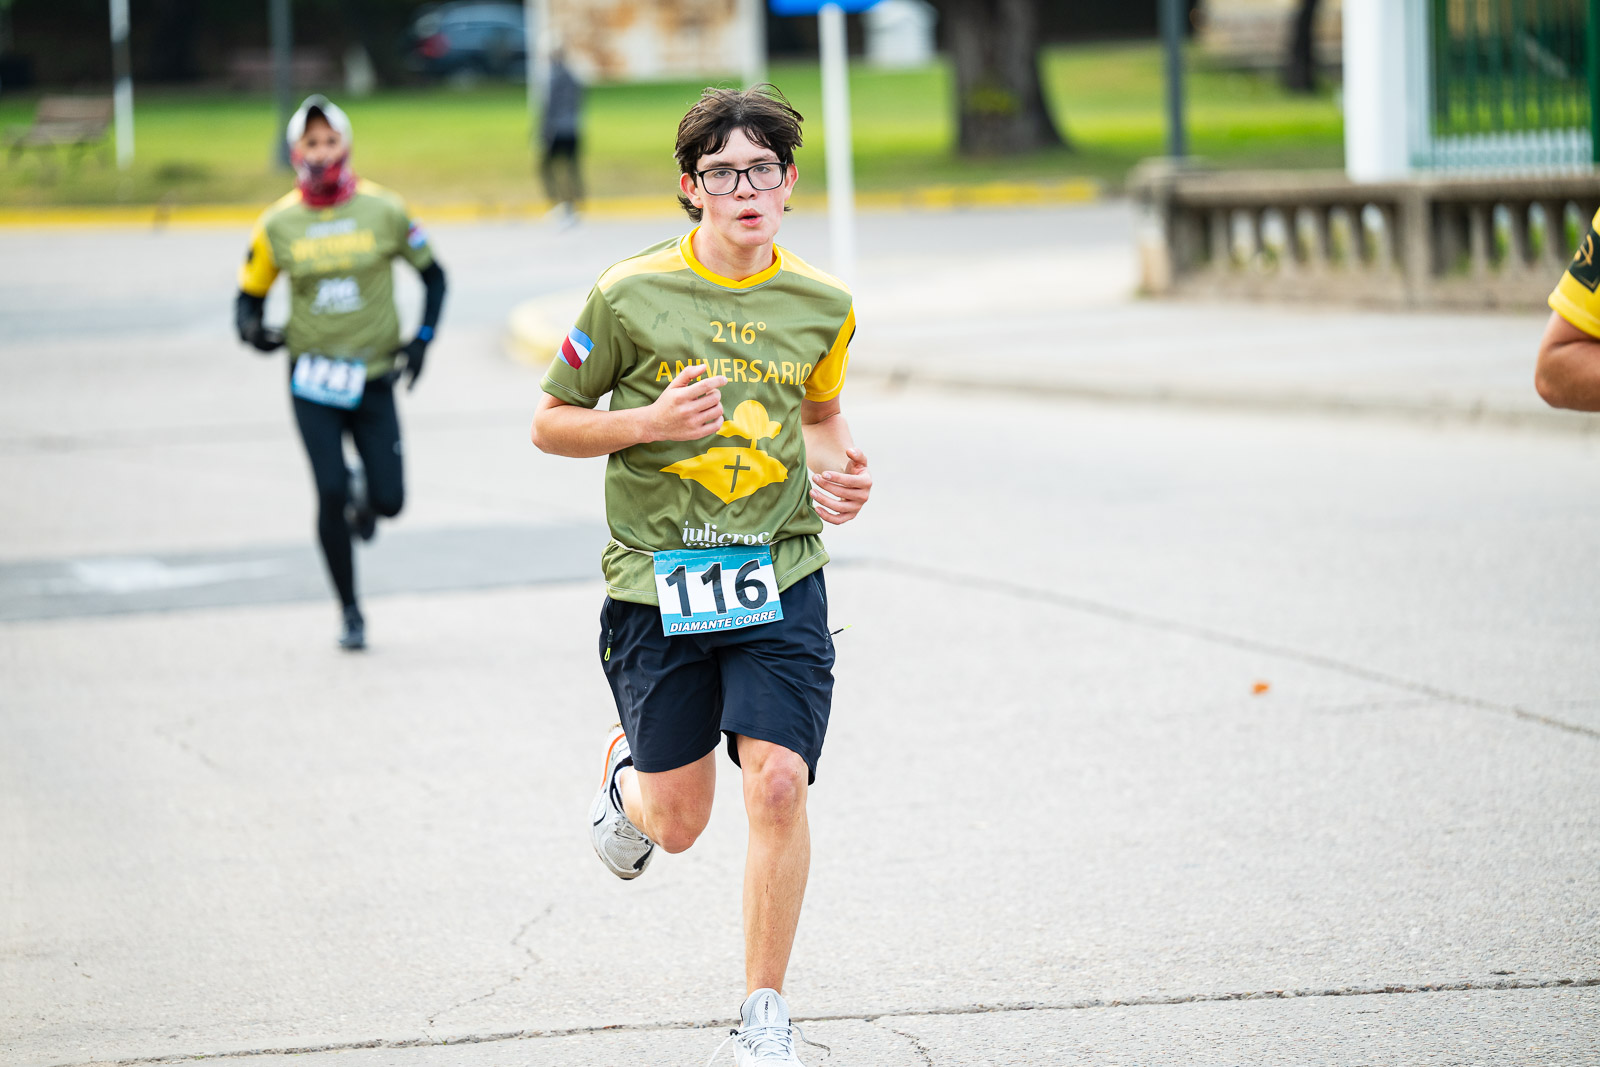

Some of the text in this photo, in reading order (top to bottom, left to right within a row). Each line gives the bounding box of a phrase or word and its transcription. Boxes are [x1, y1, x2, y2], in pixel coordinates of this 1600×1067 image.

[709, 320, 767, 345] 216°
[682, 520, 770, 545] julicroc
[664, 559, 768, 618] 116
[669, 610, 777, 633] DIAMANTE CORRE
